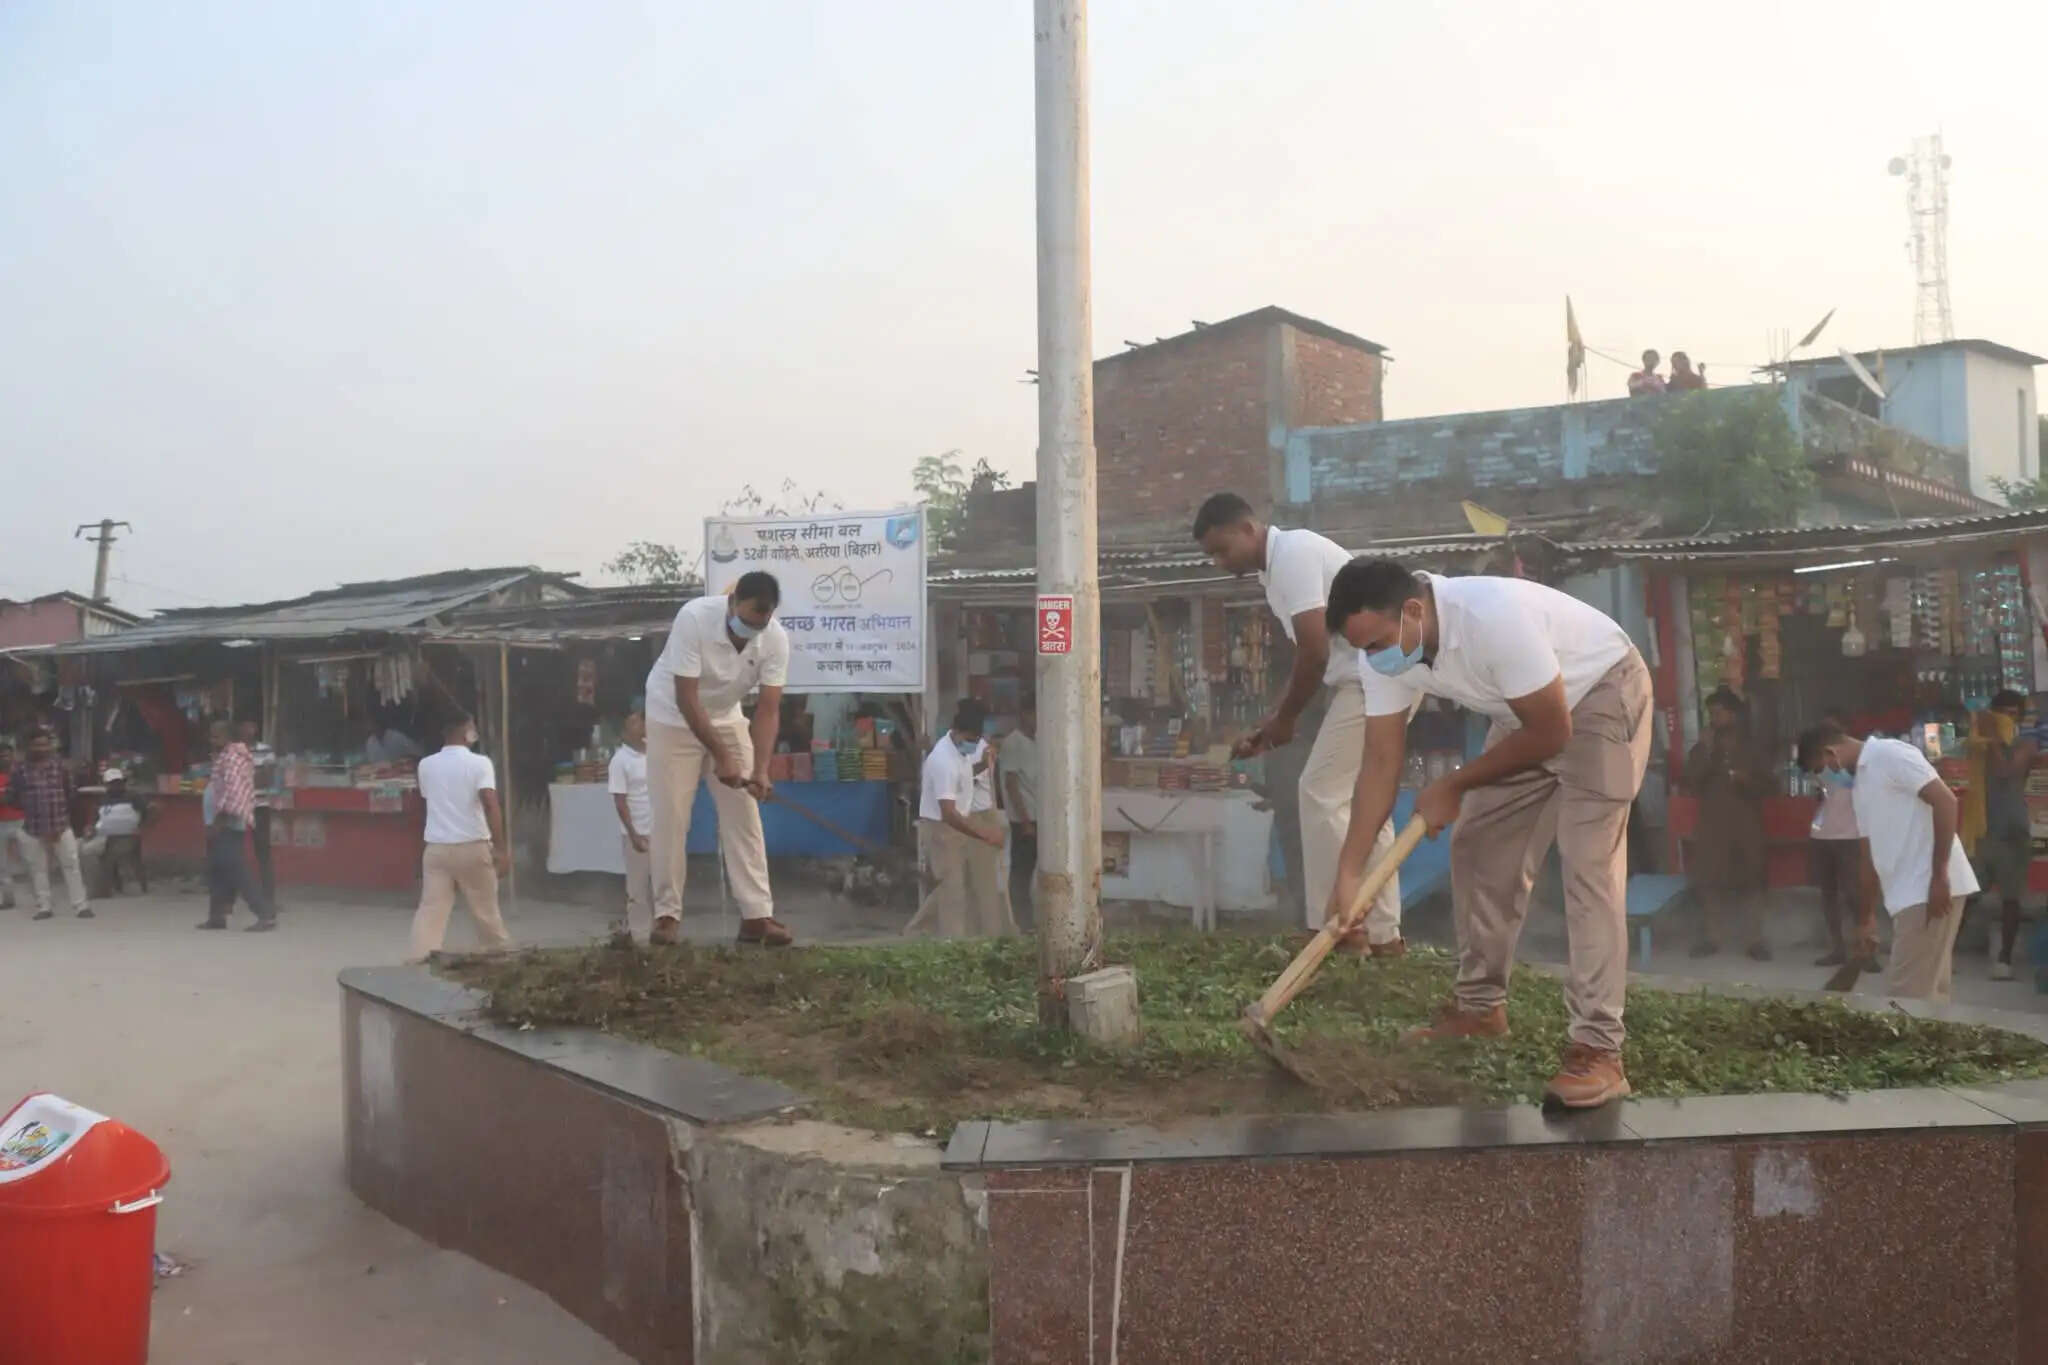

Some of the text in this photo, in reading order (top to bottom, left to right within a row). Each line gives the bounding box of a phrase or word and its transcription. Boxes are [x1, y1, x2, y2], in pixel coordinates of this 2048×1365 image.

[800, 523, 834, 540] सीमा
[805, 543, 841, 559] अररिया
[821, 616, 857, 632] भारत
[860, 612, 912, 631] अभियान
[866, 660, 893, 673] भारत
